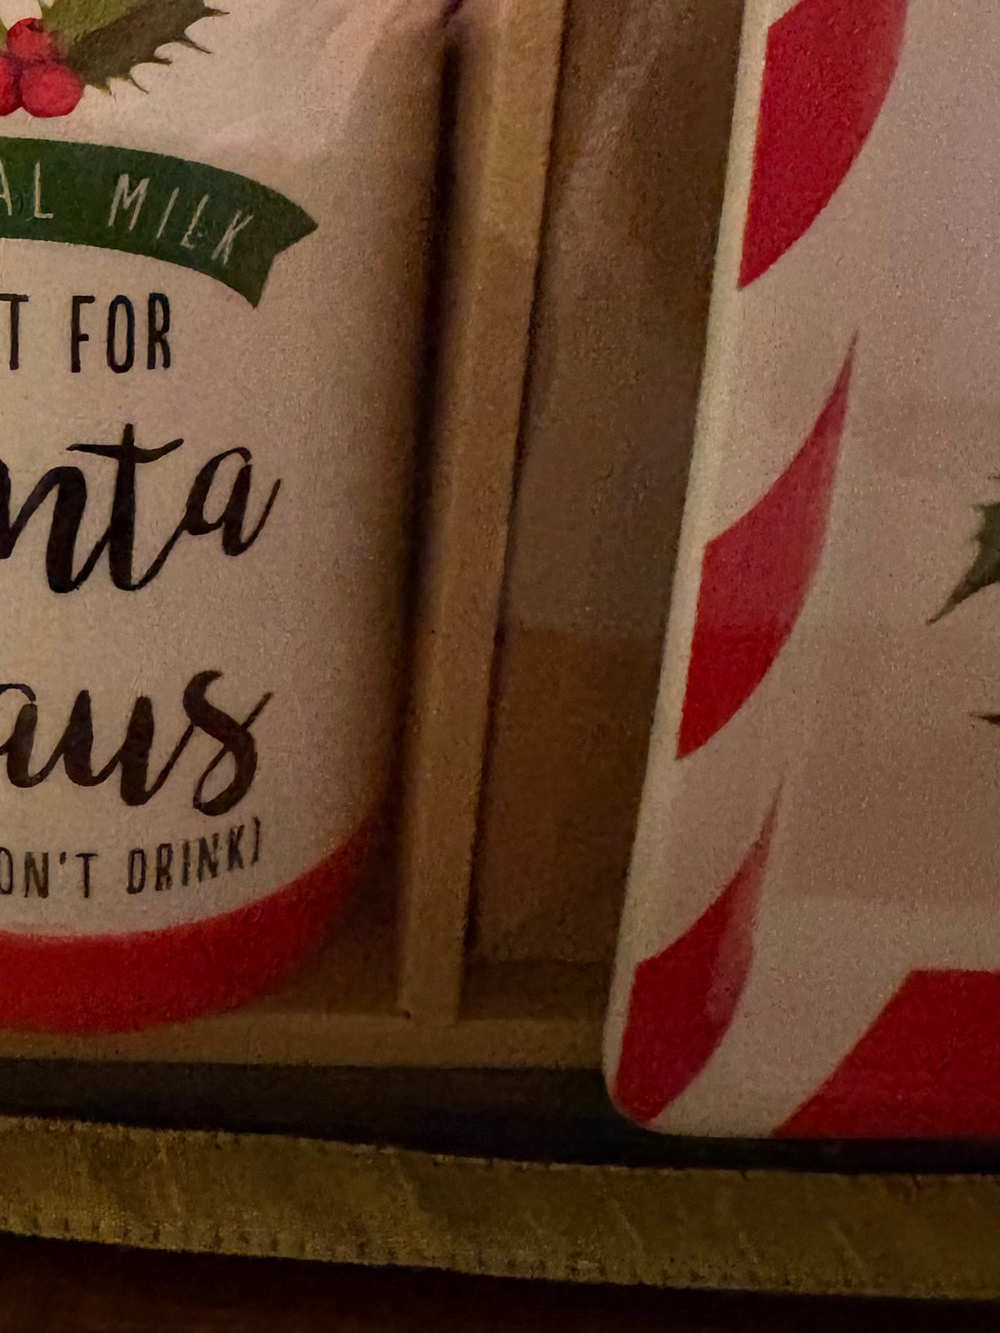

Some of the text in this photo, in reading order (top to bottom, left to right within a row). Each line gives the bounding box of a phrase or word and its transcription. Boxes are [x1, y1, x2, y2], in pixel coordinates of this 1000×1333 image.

[107, 173, 255, 265] MILK
[70, 292, 172, 374] FOR
[125, 815, 263, 896] DRINK)
